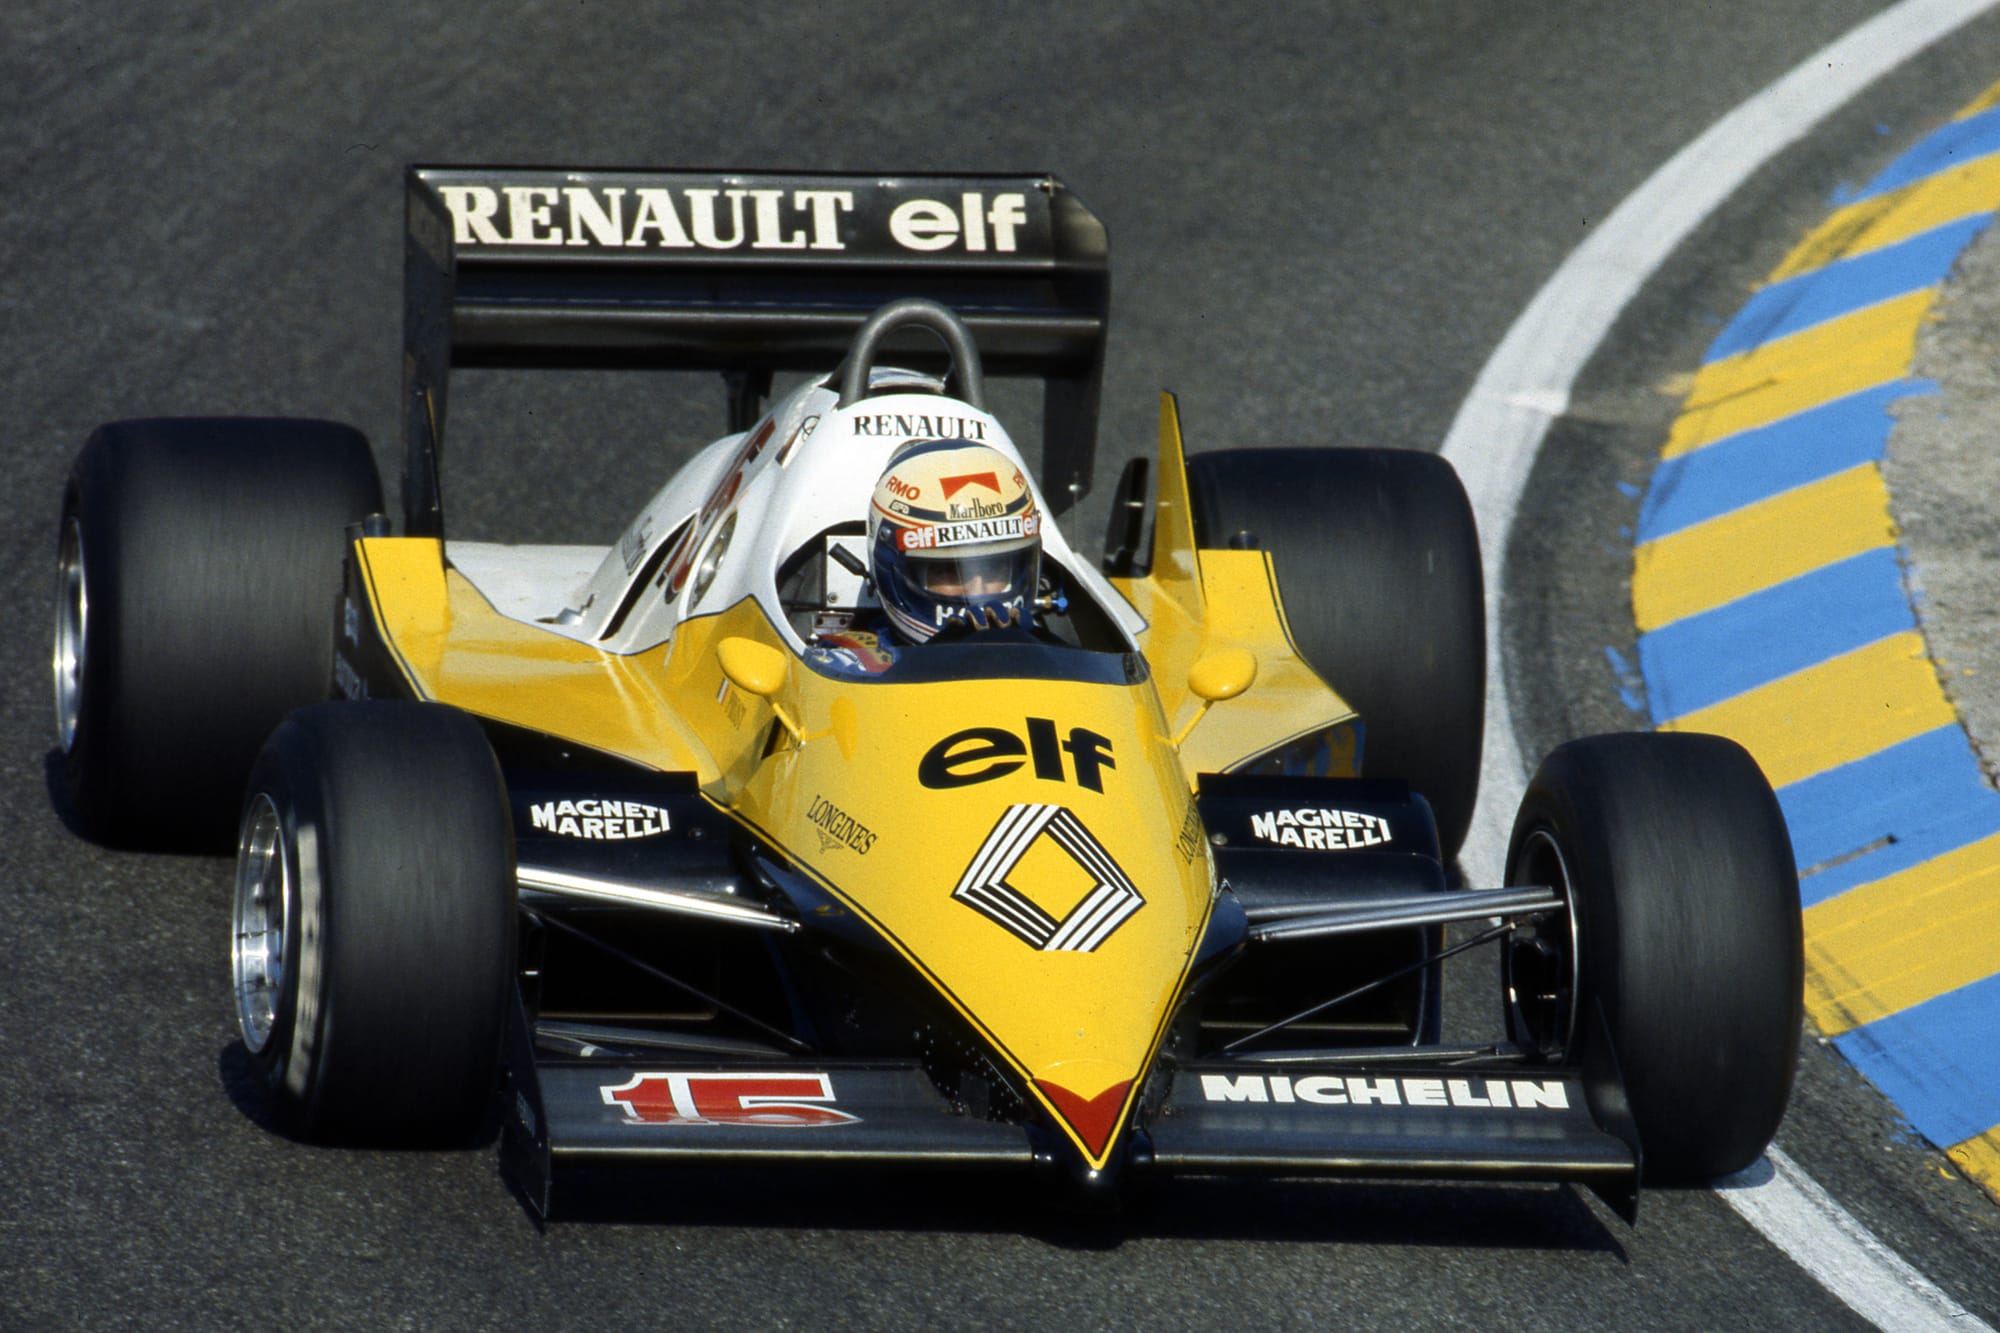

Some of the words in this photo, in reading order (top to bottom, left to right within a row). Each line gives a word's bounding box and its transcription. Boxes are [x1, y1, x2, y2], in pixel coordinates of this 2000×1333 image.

[438, 186, 853, 250] RENAULT
[890, 192, 1026, 251] elf
[853, 414, 987, 440] RENAULT
[885, 475, 921, 501] RMO
[949, 497, 1004, 519] Marlboro
[902, 527, 936, 550] elf
[937, 518, 1022, 544] RENAULT
[918, 716, 1117, 795] elf
[531, 800, 671, 827] MAGNETI
[531, 810, 671, 840] MARELLI
[806, 794, 878, 855] LONGINES
[1251, 809, 1392, 836] MAGNETI
[1251, 820, 1392, 850] MARELLI
[600, 1072, 864, 1128] 15
[1201, 1075, 1570, 1110] MICHELIN
